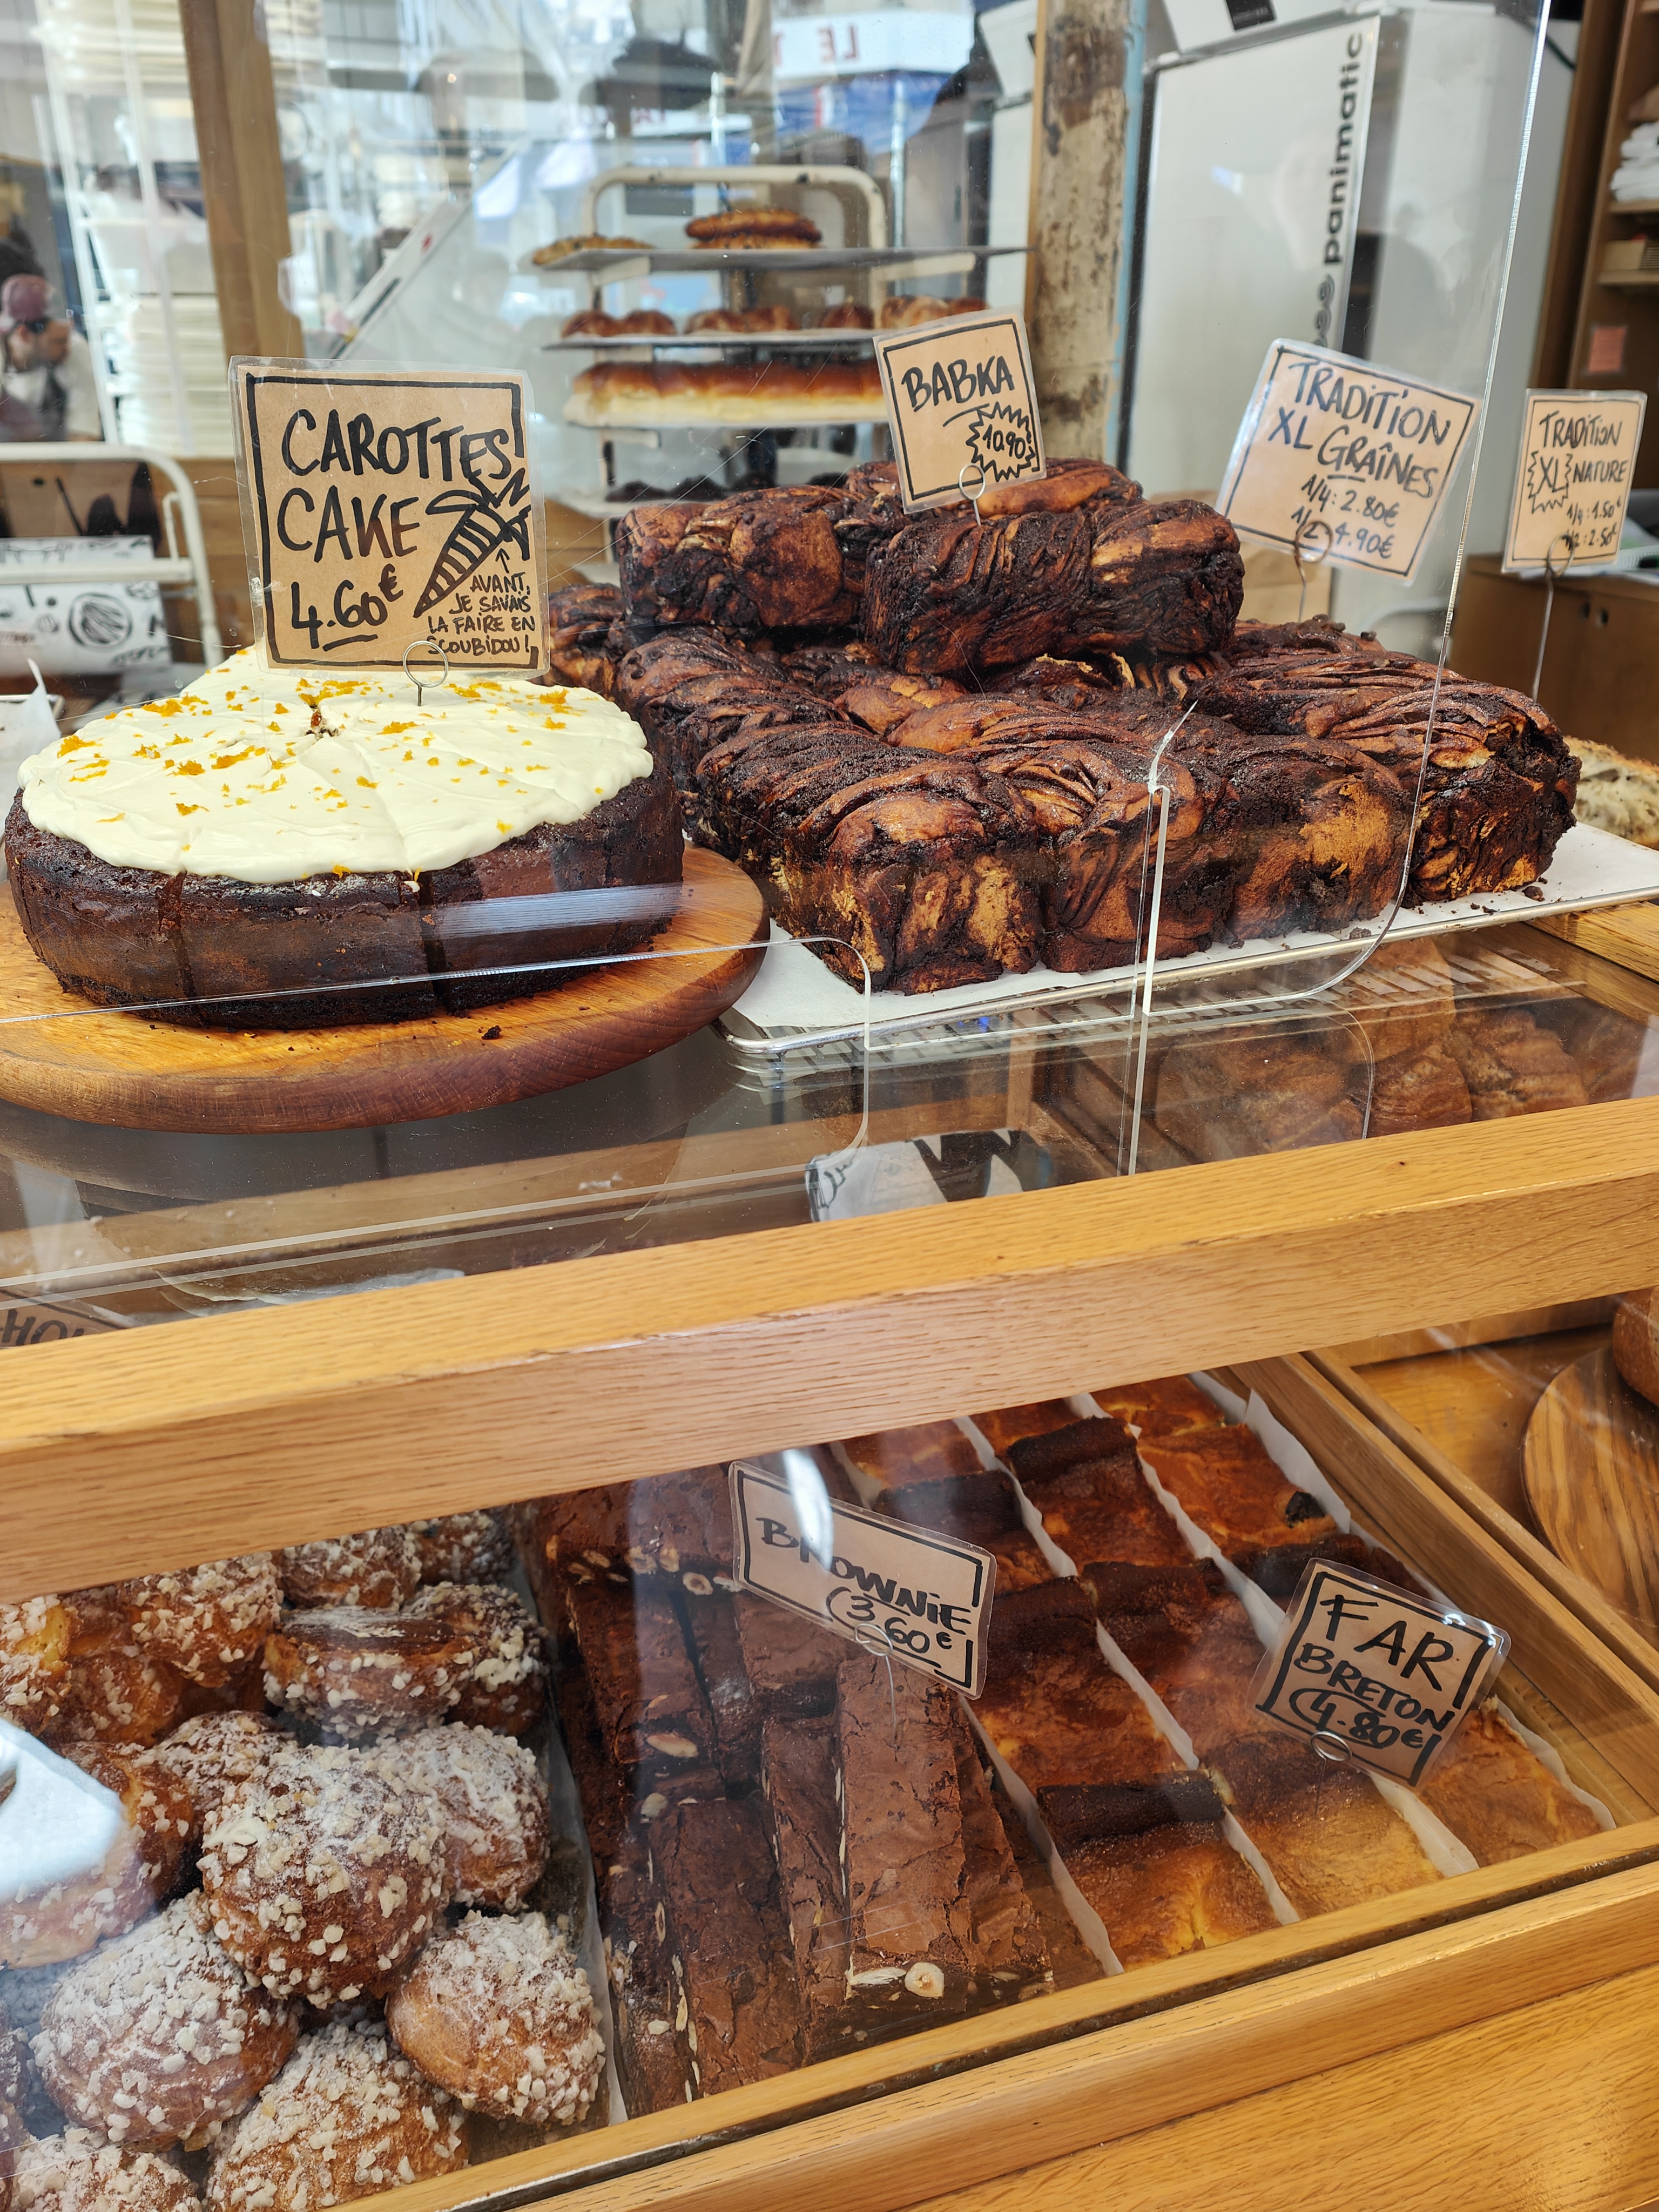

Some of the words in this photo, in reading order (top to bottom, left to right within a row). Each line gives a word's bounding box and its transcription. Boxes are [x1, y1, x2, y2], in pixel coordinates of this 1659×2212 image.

[1323, 31, 1364, 265] panimatic
[901, 355, 1015, 412] BABKA
[281, 409, 512, 482] CAROTTES
[1268, 407, 1313, 449] XL
[1573, 460, 1629, 483] NATURE
[277, 485, 420, 563] CAKE
[291, 563, 404, 649] 4.60€
[427, 616, 449, 635] LA
[510, 616, 536, 633] EN
[448, 593, 473, 615] JE
[1320, 1594, 1454, 1691] FAR
[1294, 1643, 1456, 1731] BRETON
